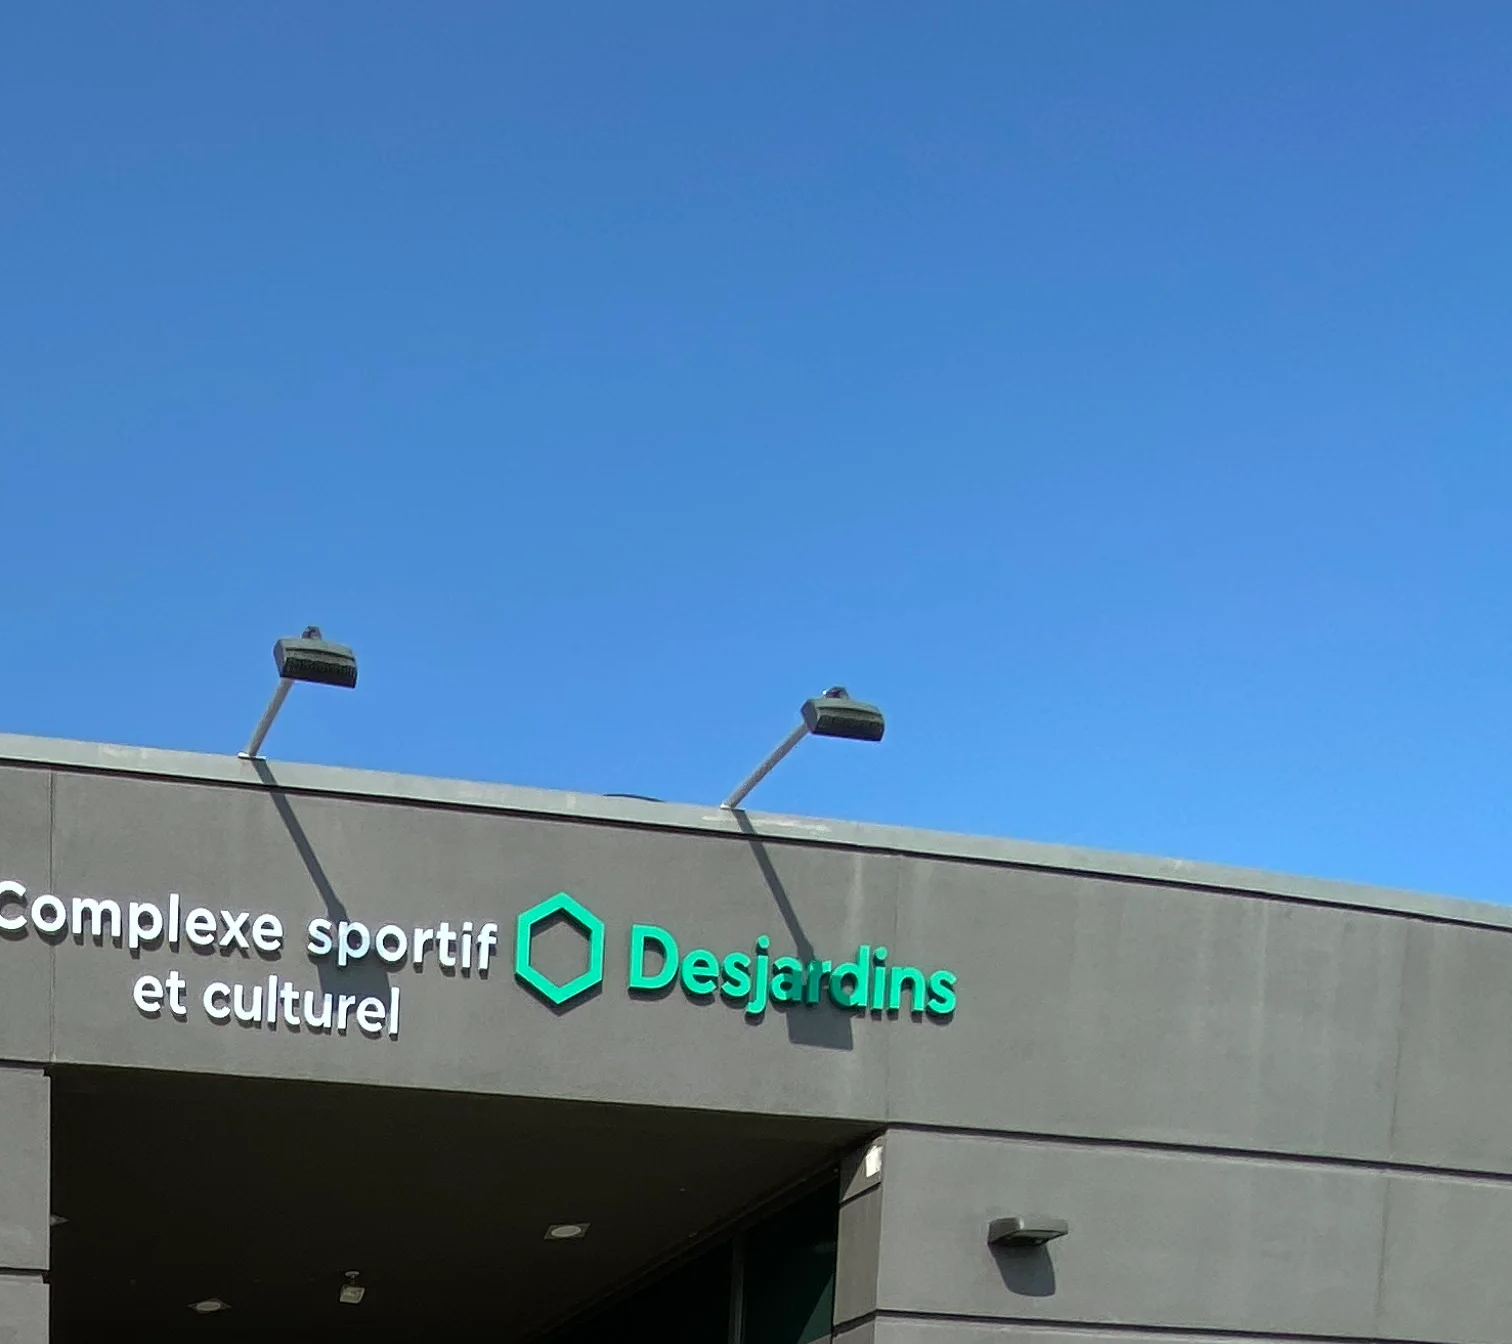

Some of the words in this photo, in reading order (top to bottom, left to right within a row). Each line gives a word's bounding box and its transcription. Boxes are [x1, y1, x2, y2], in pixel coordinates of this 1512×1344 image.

[307, 917, 499, 971] sportif
[629, 924, 958, 1015] Desjardins
[133, 970, 188, 1016] et
[203, 973, 400, 1035] culturel
